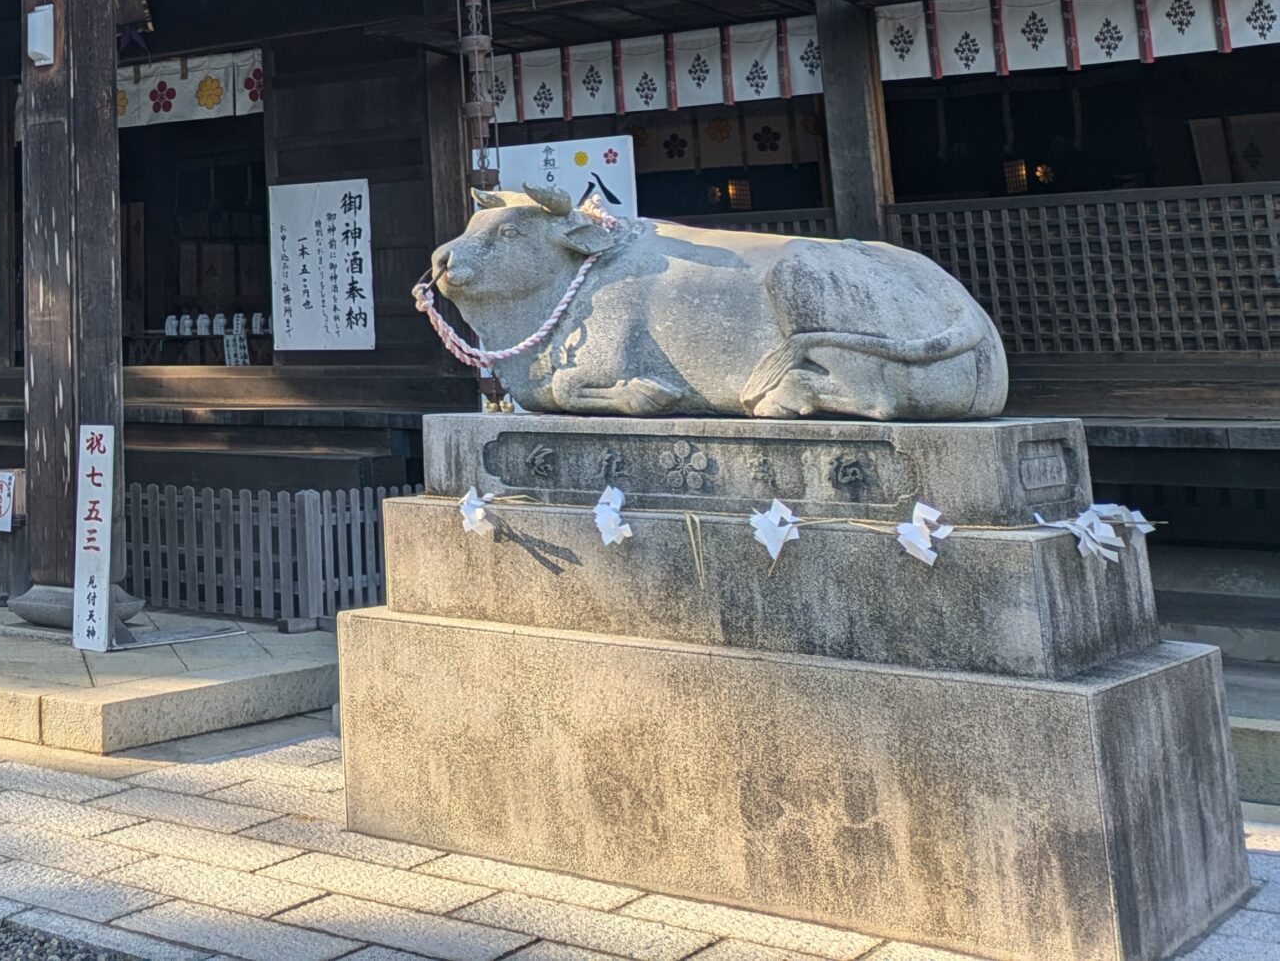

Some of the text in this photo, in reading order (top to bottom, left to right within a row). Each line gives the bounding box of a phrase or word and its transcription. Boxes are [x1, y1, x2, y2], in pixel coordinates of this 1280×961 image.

[577, 171, 622, 207] 八
[340, 191, 368, 331] 御神酒奉納
[82, 431, 107, 552] 祝七五三
[86, 574, 97, 641] 見付天神
